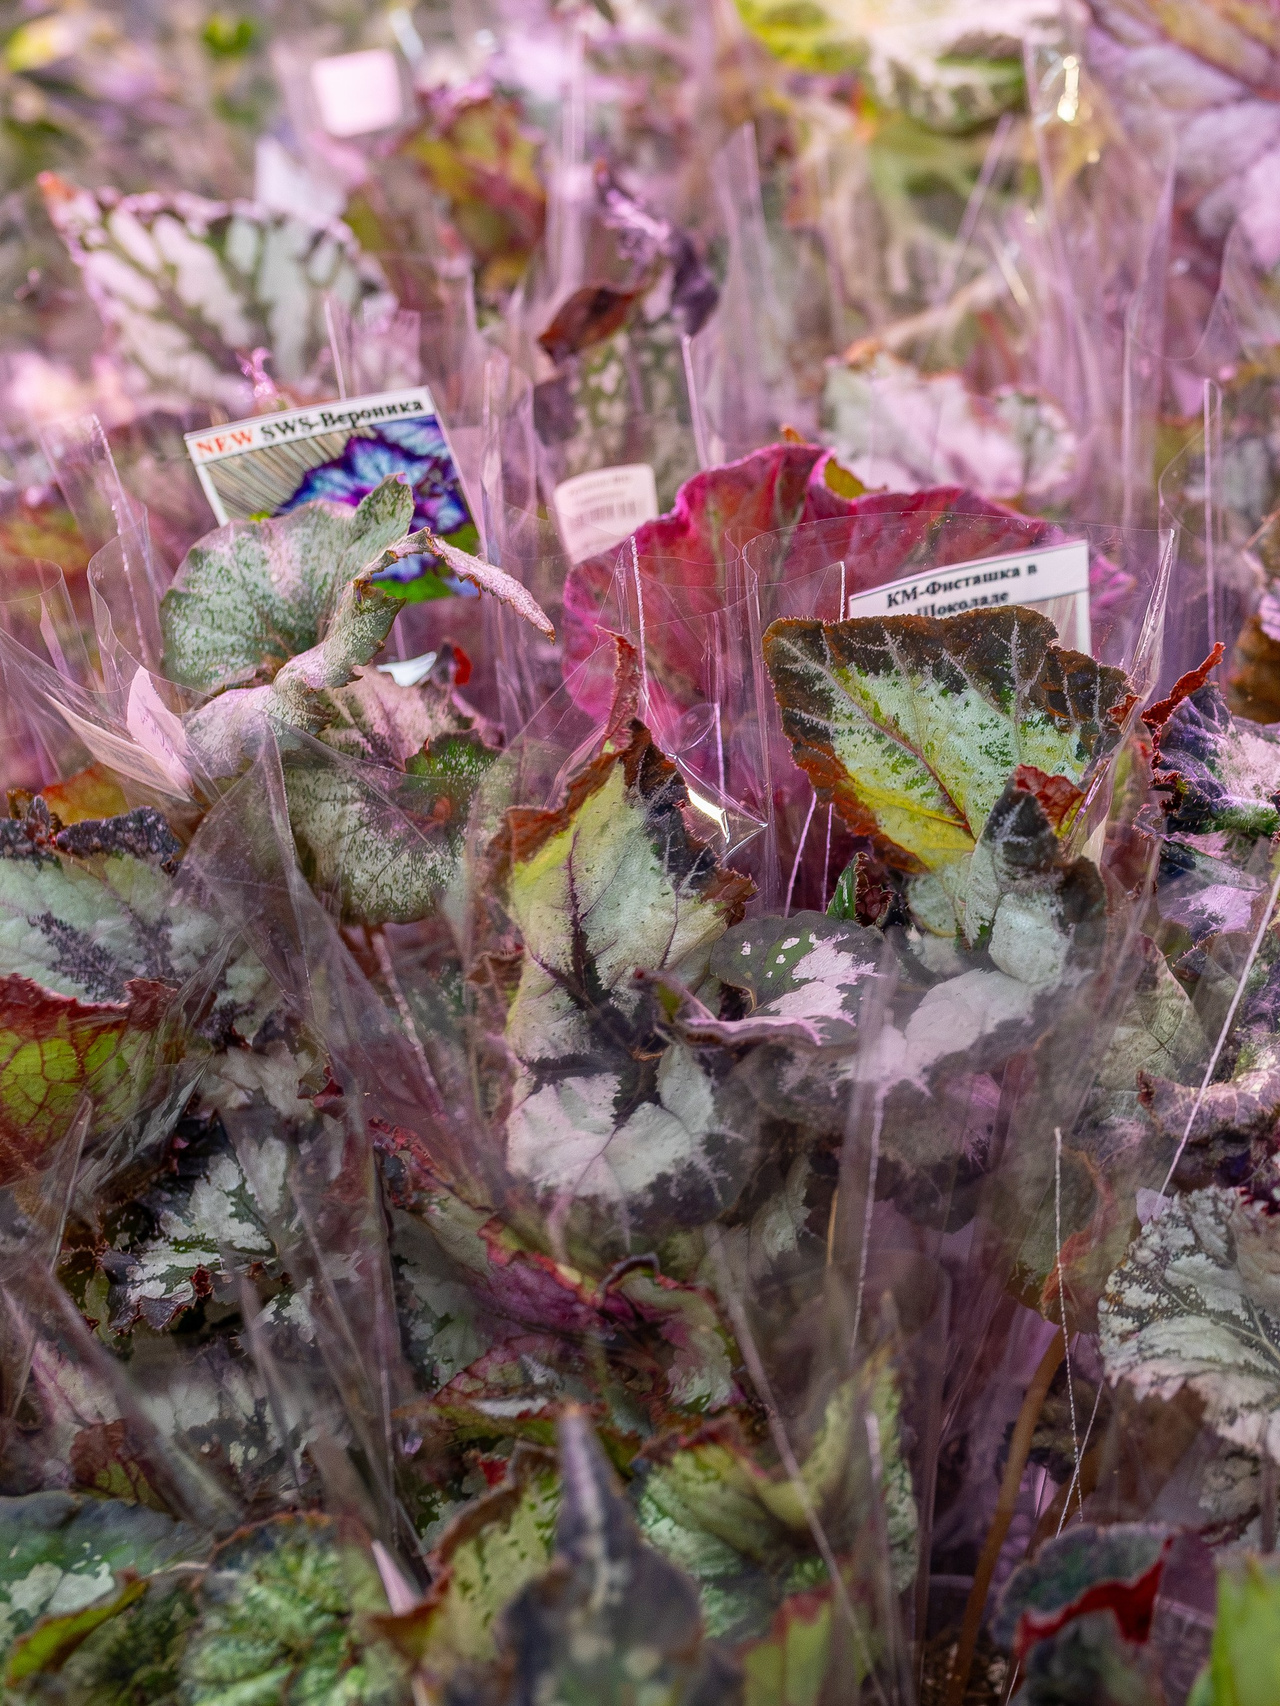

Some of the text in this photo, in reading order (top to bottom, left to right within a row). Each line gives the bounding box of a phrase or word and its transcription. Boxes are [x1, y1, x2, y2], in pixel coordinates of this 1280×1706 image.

[195, 400, 424, 458] NEW SWS-Вероника
[886, 564, 1037, 608] КМ-Фисташка в
